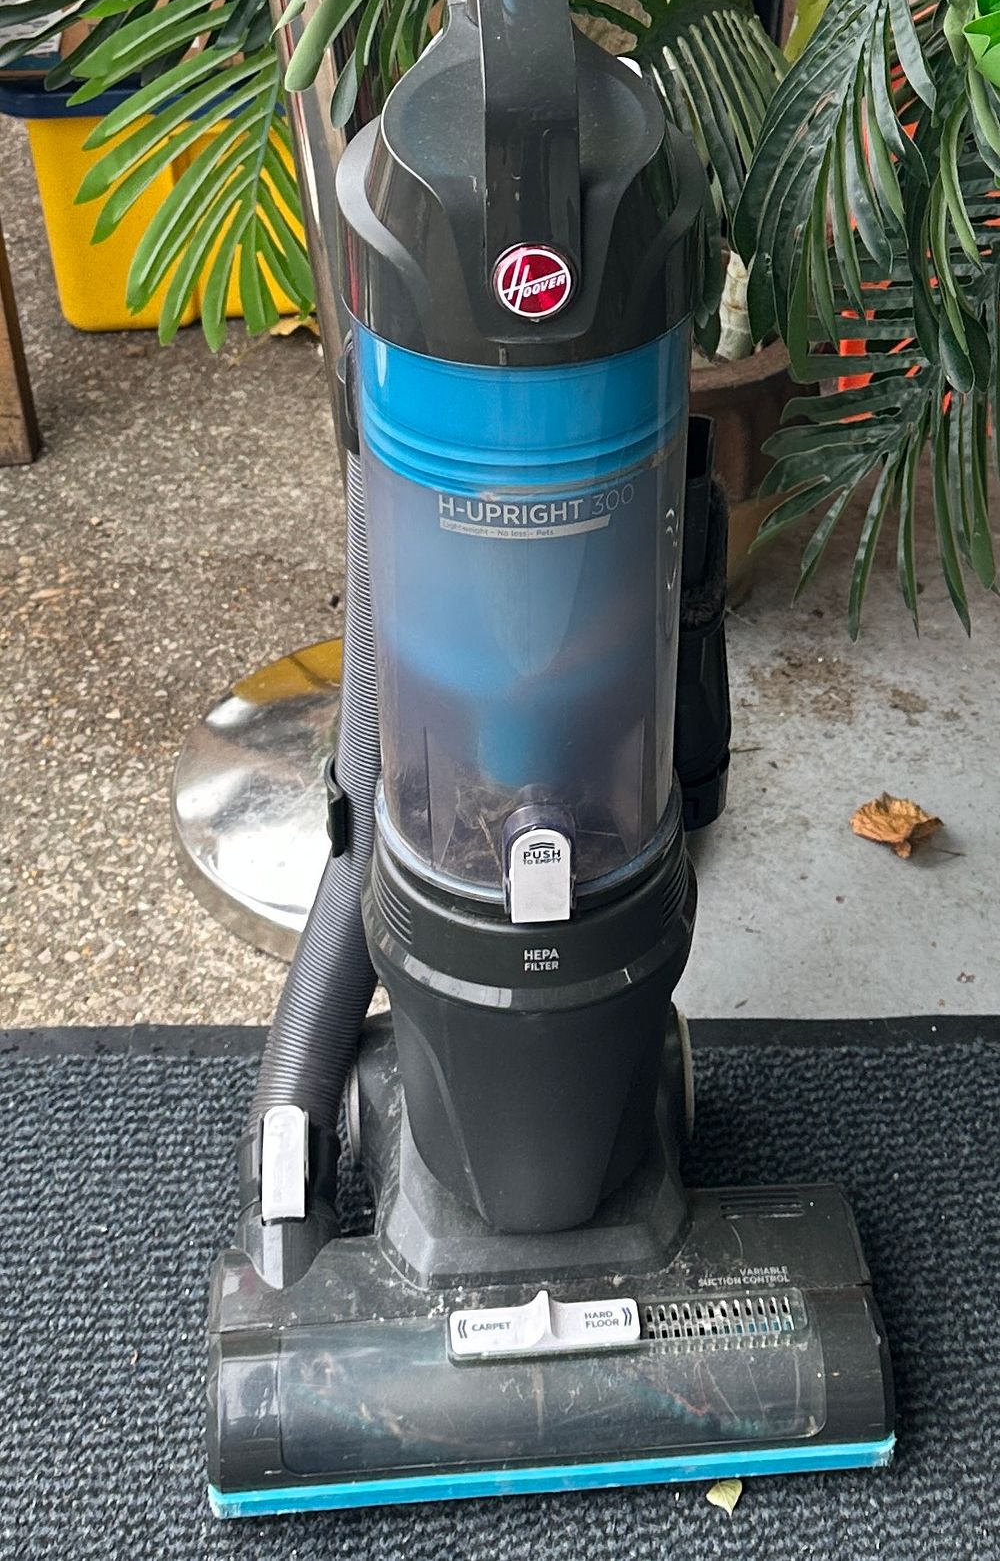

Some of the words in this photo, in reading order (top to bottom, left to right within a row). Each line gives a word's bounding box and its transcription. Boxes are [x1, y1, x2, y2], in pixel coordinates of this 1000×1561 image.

[438, 494, 584, 525] H-UPRIGHT
[592, 483, 635, 516] 300
[537, 528, 554, 537] Pets
[523, 850, 561, 860] PUSH
[535, 857, 561, 865] EMPTY
[524, 948, 559, 961] HEPA
[524, 961, 559, 971] FILTER
[740, 1266, 788, 1276] VARIABLE
[698, 1277, 741, 1287] SUCTION
[742, 1274, 790, 1284] CONTROL
[584, 1310, 613, 1319] HARD
[471, 1321, 512, 1332] CARPET
[585, 1319, 620, 1329] FLOOR
